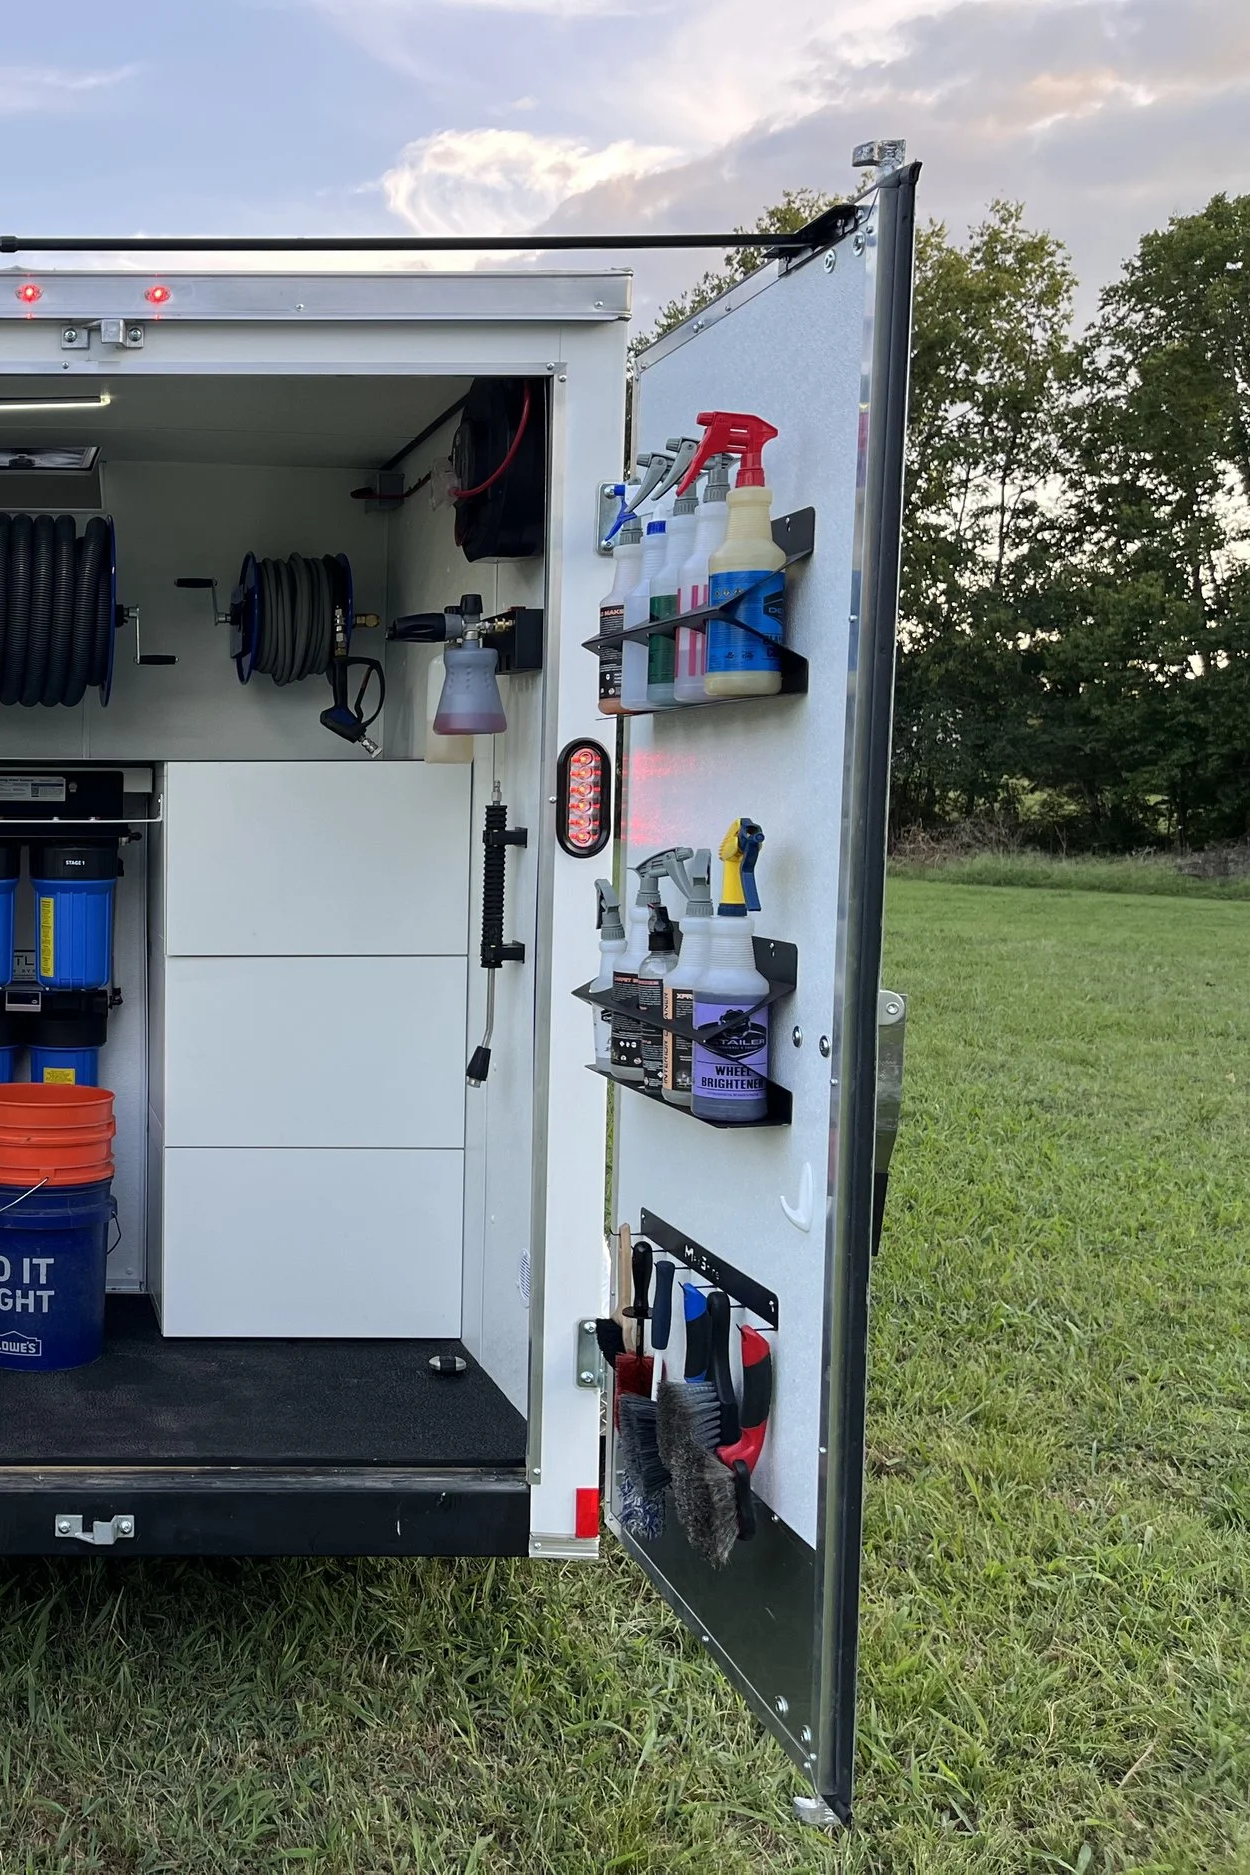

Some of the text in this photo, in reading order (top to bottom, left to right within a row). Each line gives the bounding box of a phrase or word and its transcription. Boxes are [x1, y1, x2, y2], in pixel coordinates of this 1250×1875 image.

[715, 1065, 751, 1077] WHEEL
[701, 1076, 764, 1090] BRIGHTENER
[23, 1257, 54, 1284] IT
